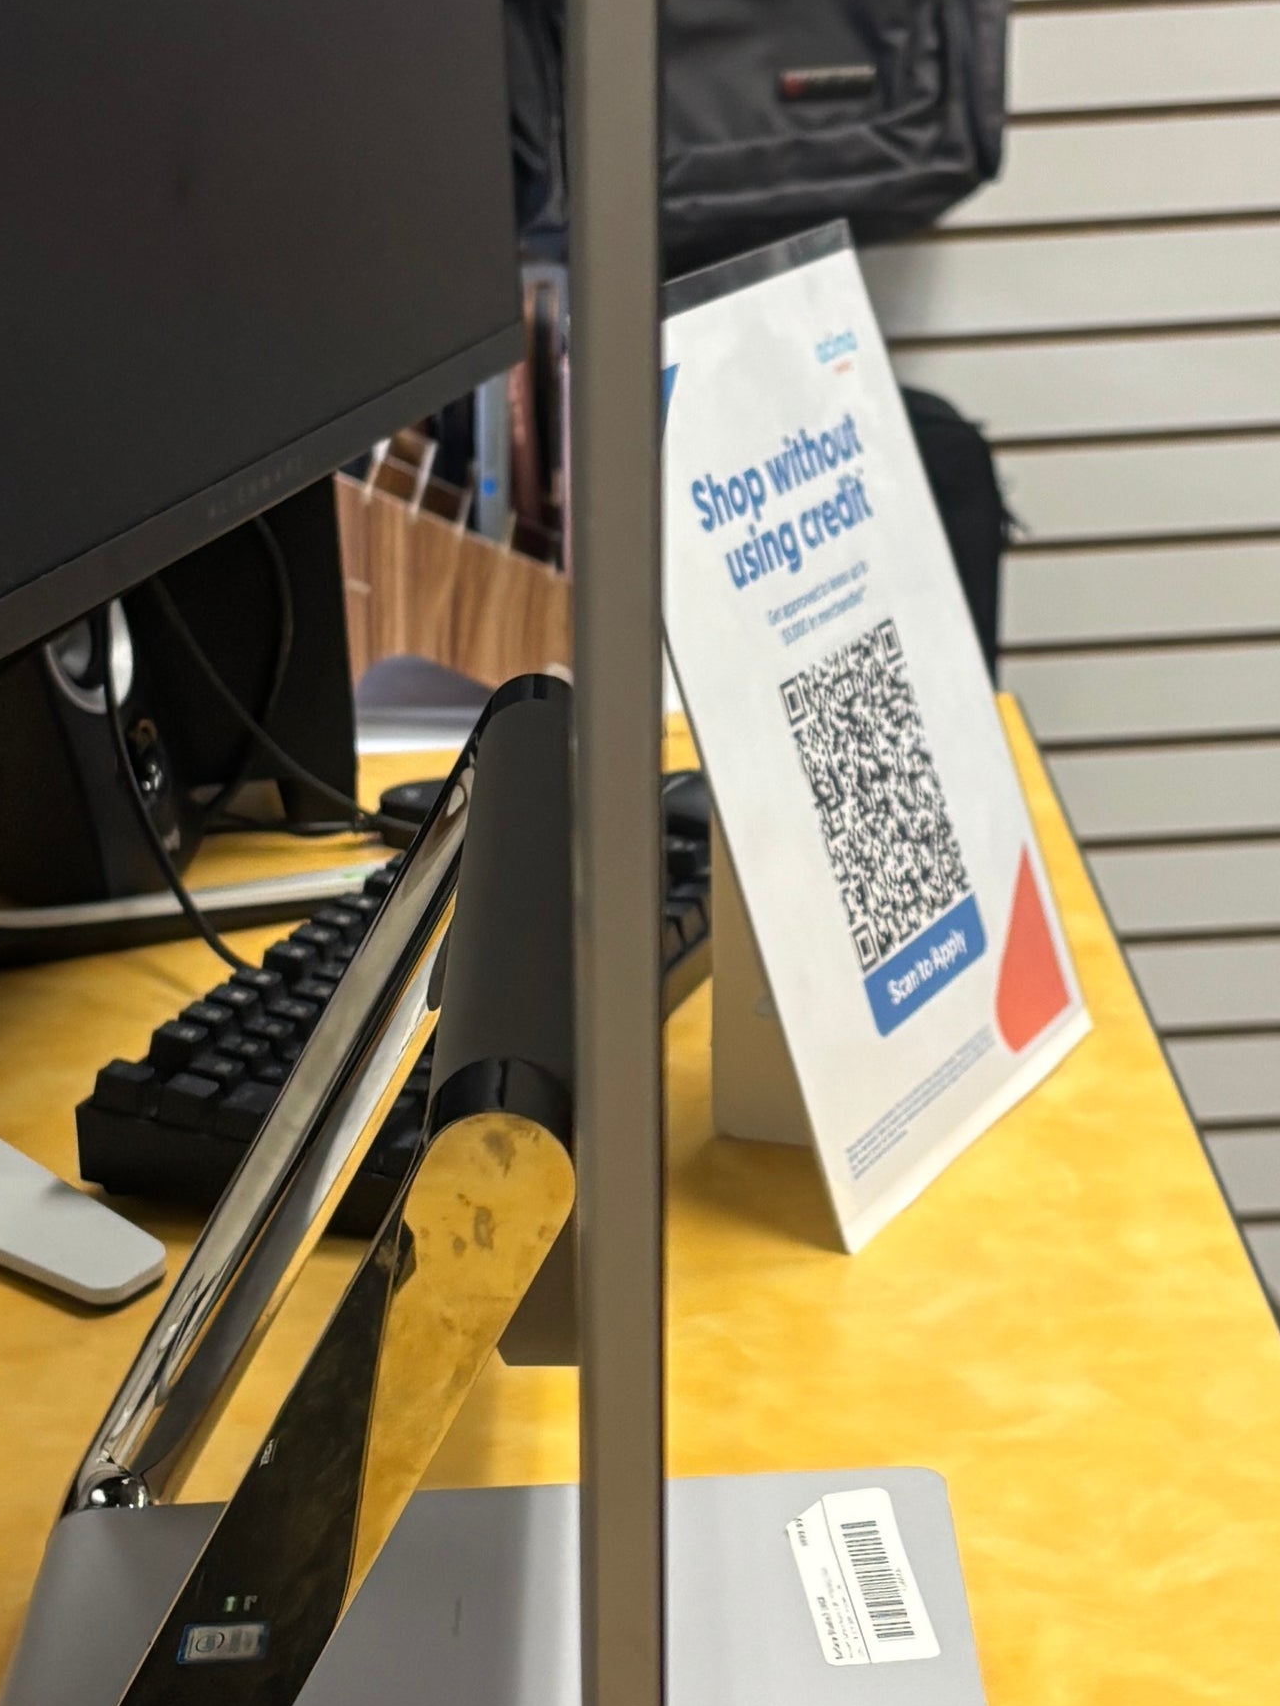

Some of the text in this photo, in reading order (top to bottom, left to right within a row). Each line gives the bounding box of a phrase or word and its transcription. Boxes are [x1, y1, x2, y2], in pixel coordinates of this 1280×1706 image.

[691, 411, 865, 532] Shop without
[725, 522, 802, 590] using
[886, 929, 969, 1006] Scan to Apply
